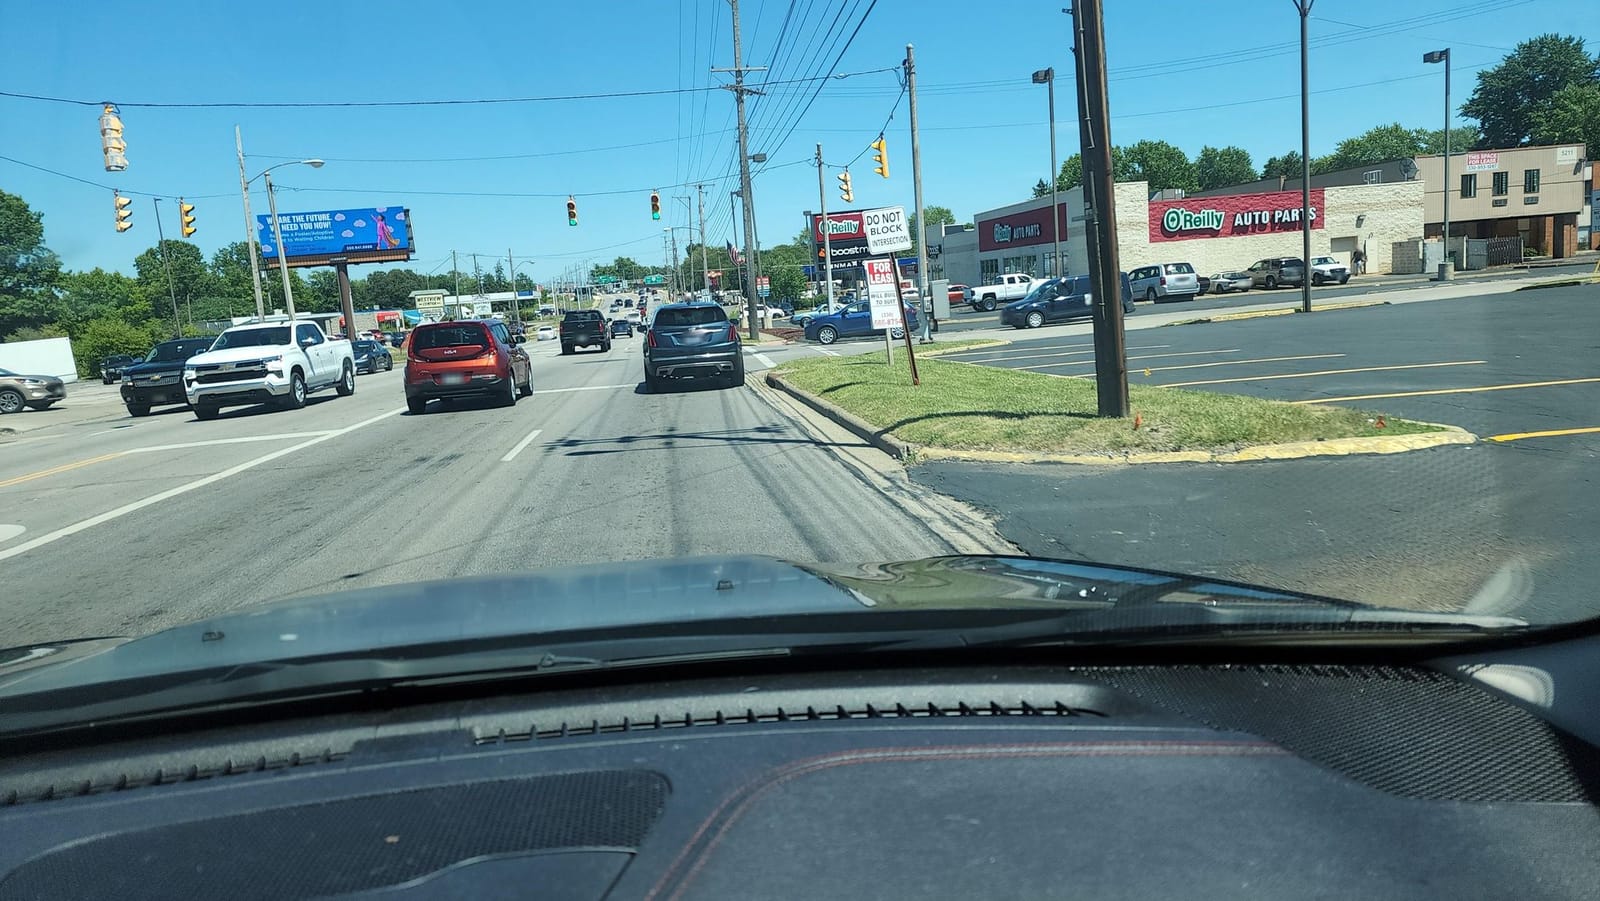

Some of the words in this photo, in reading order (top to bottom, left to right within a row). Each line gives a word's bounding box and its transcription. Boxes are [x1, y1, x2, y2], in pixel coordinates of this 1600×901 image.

[278, 215, 291, 224] ARE
[291, 214, 305, 223] THE
[867, 215, 880, 225] DO
[882, 211, 901, 223] NOT
[1164, 208, 1225, 232] O'Reilly
[1234, 211, 1270, 226] AUTO
[281, 223, 299, 232] NEED
[299, 222, 313, 231] YOU
[819, 219, 859, 234] O'Reilly
[870, 224, 903, 236] BLOCK
[1013, 226, 1025, 239] AUTO
[1025, 223, 1040, 238] PARTS
[872, 235, 909, 247] INTERSECTION
[873, 262, 891, 273] FOR
